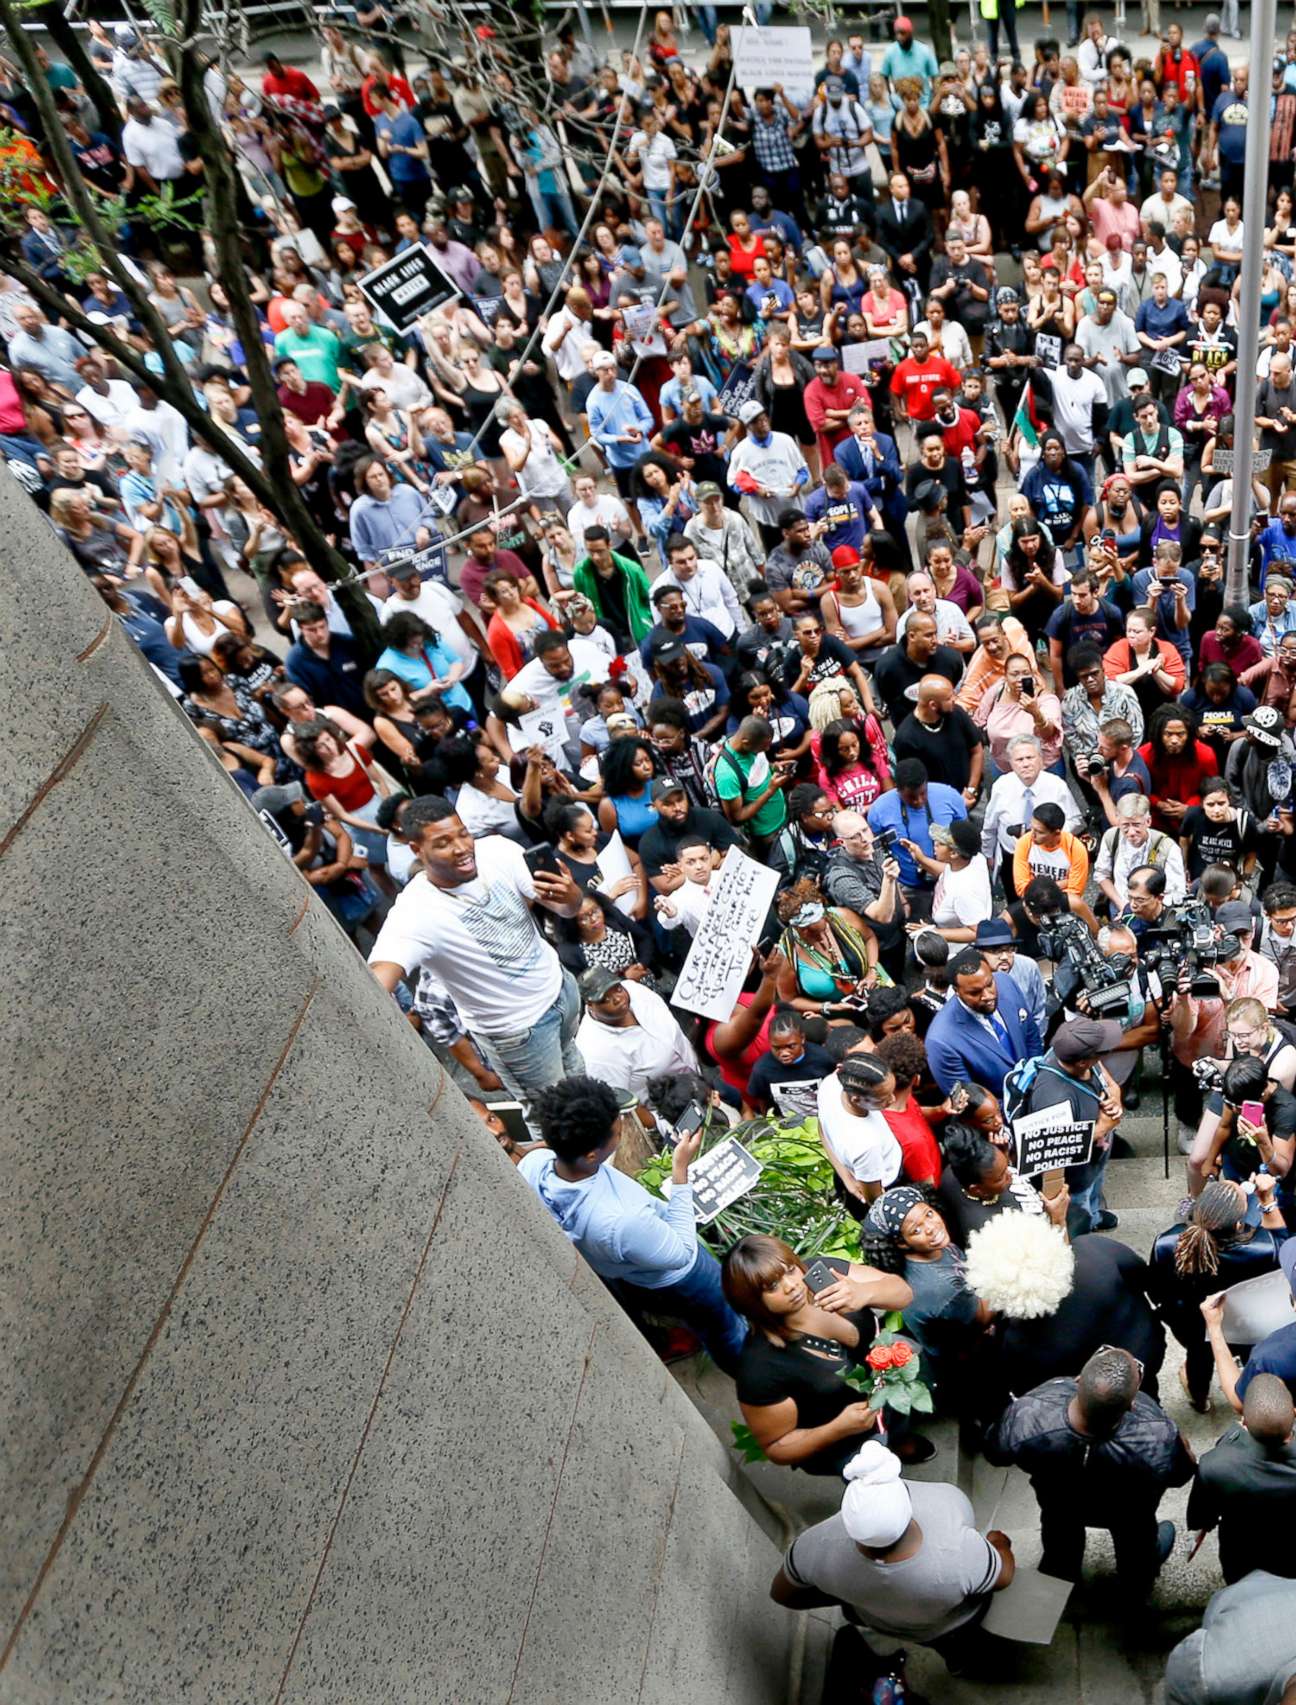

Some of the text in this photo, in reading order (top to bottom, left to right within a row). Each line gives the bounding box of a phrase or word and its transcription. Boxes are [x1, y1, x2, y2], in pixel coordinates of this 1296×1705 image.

[838, 773, 879, 797] CHILL
[1029, 863, 1067, 877] NEVER
[1024, 1122, 1089, 1140] NO JUSTICE
[1028, 1133, 1083, 1151] NO PEACE
[1025, 1145, 1084, 1163] NO RACIST
[693, 1152, 738, 1193] NO PEACE
[1033, 1157, 1073, 1173] POLICE
[698, 1159, 747, 1204] NO RACIST
